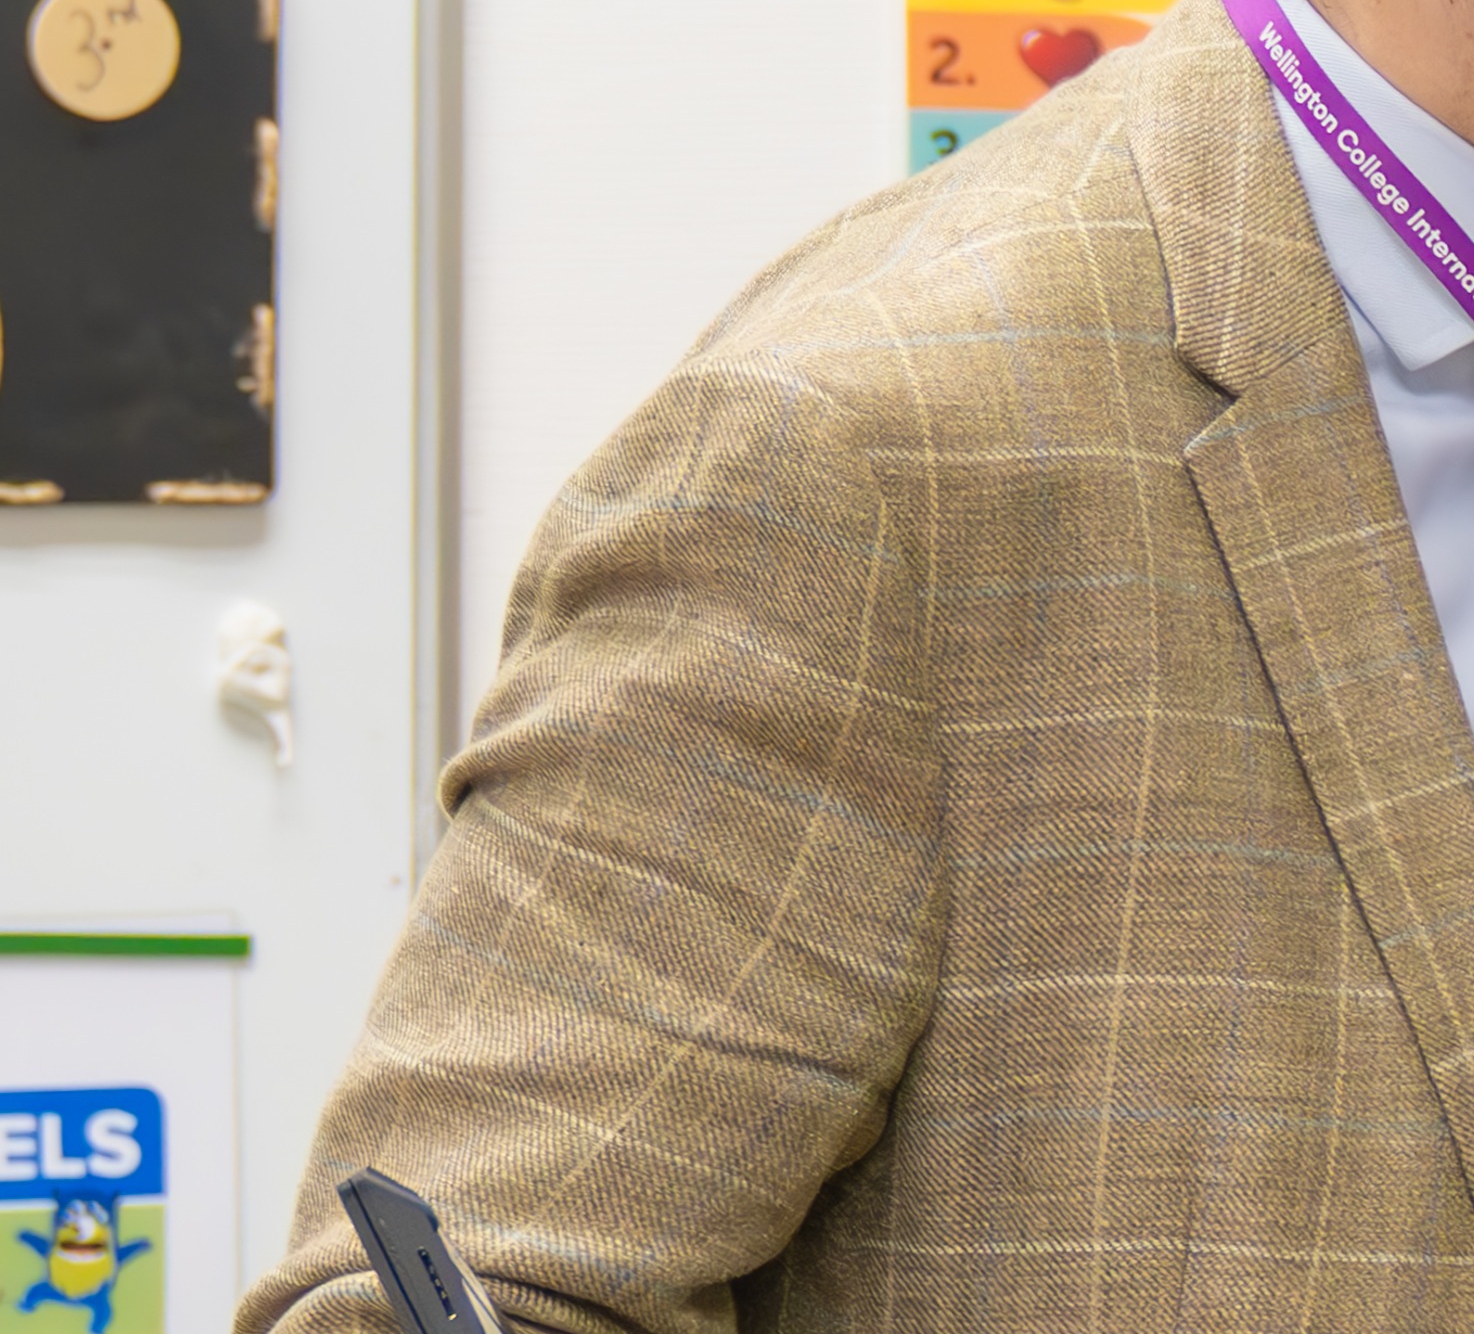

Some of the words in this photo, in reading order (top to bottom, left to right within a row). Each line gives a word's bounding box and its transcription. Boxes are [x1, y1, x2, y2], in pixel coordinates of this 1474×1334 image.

[928, 36, 977, 86] 2.
[1258, 20, 1339, 134] Wellington
[1336, 129, 1411, 215] College
[0, 1108, 143, 1182] ELS
